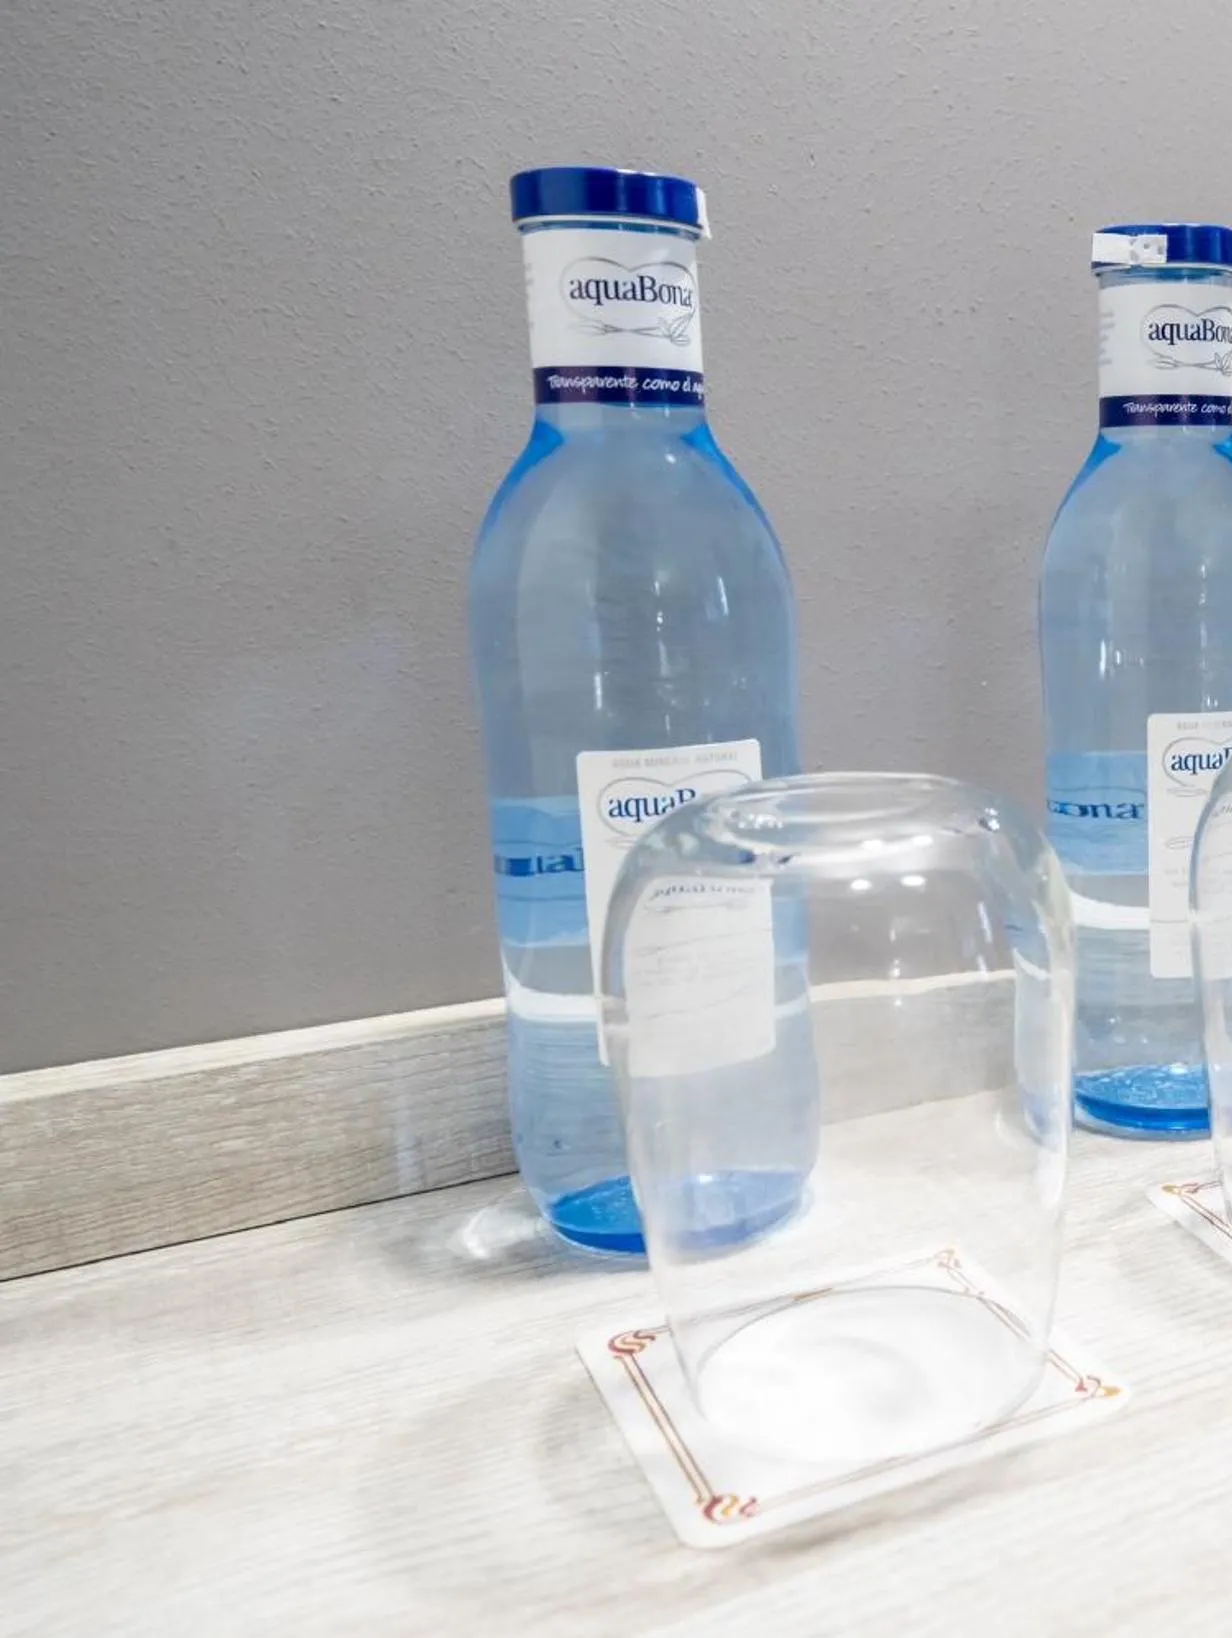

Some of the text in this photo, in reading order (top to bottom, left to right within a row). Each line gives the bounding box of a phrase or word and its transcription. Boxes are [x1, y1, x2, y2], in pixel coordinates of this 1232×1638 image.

[570, 274, 693, 308] aquaBona
[548, 374, 639, 395] Transparente
[641, 377, 680, 392] como
